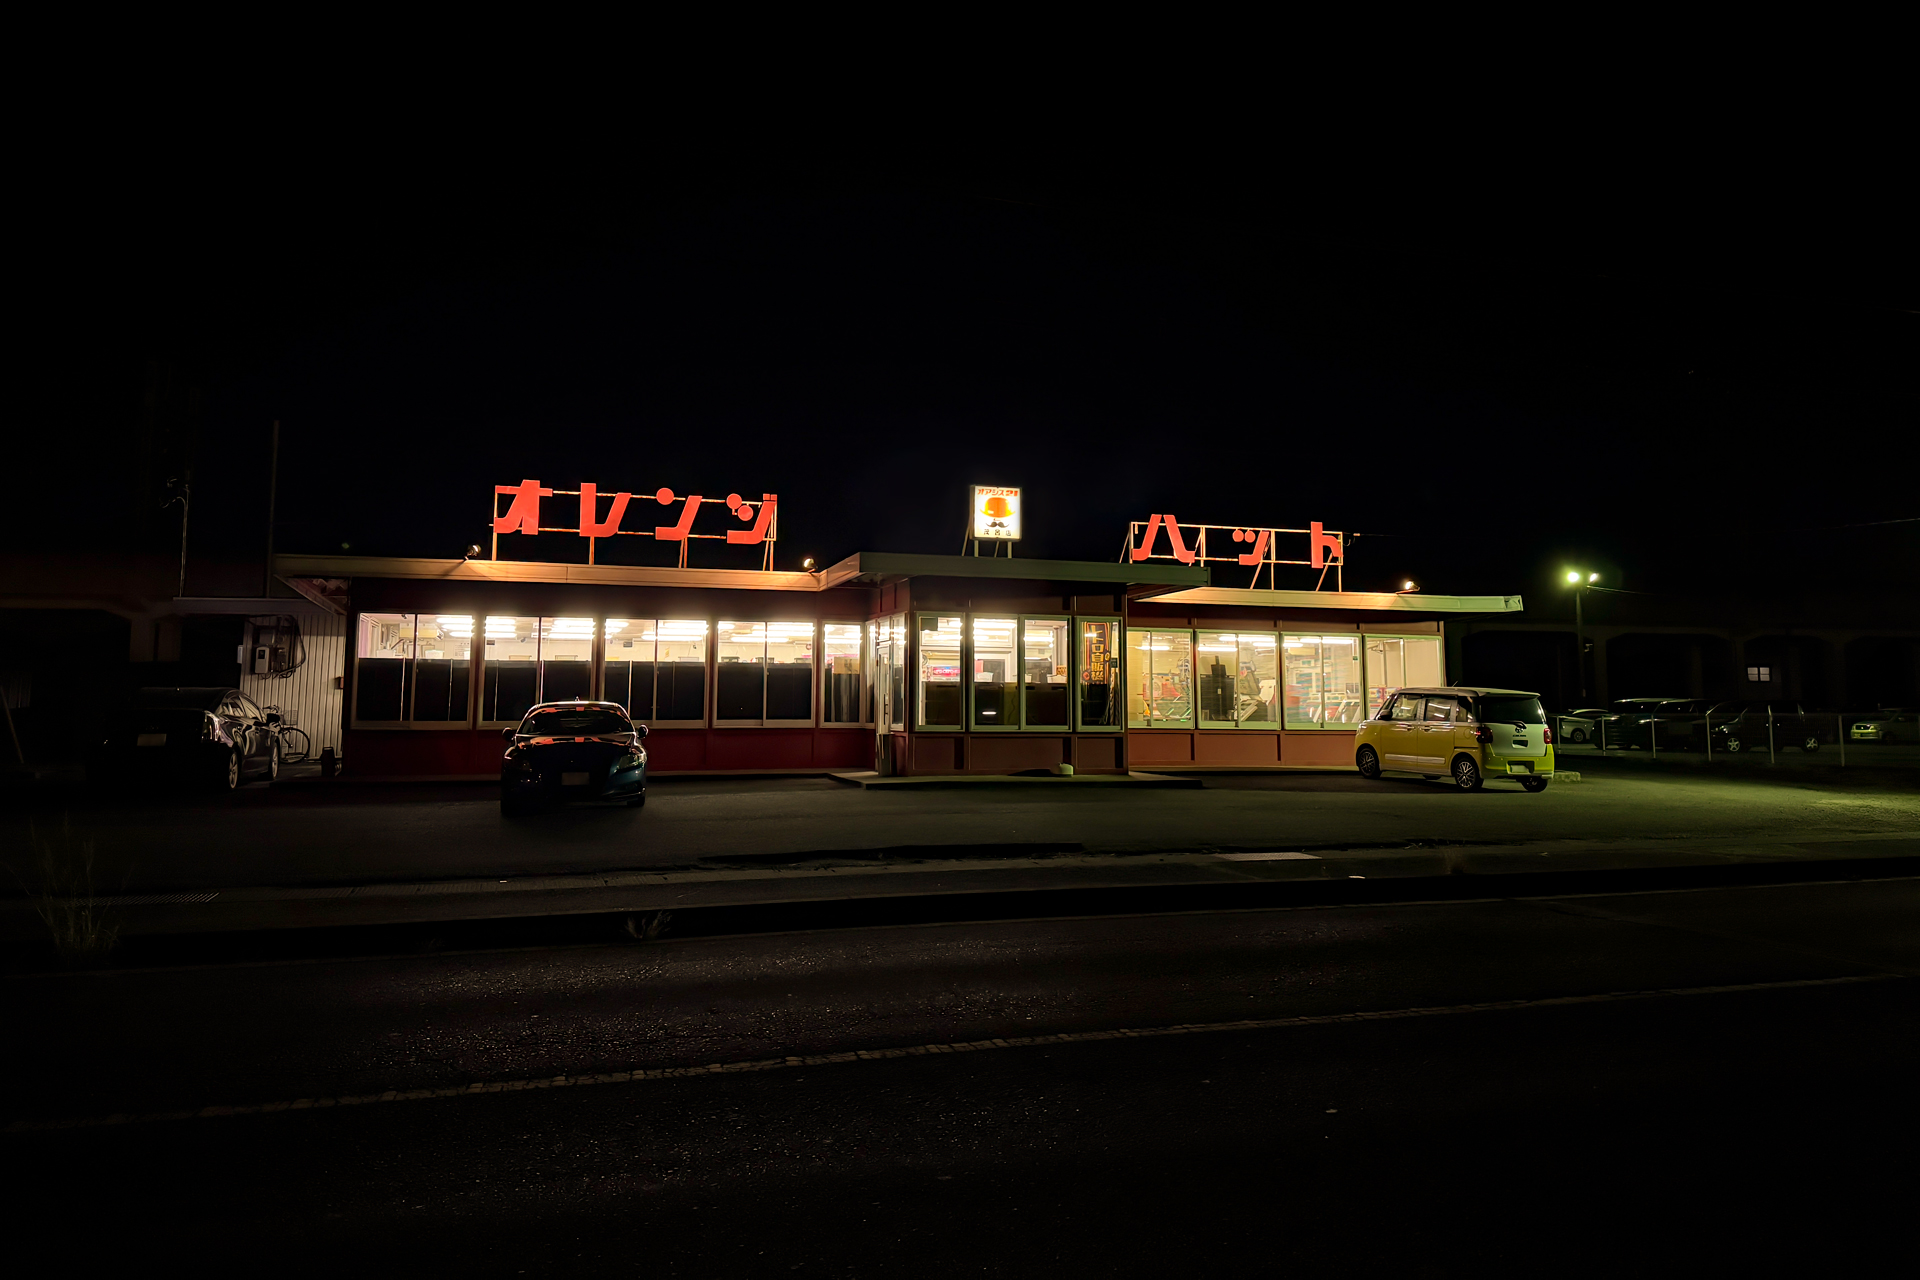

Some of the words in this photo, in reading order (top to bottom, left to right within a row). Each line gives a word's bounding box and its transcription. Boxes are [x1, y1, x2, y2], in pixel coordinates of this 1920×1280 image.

[493, 479, 777, 545] オレンジ
[1132, 513, 1343, 569] ハット
